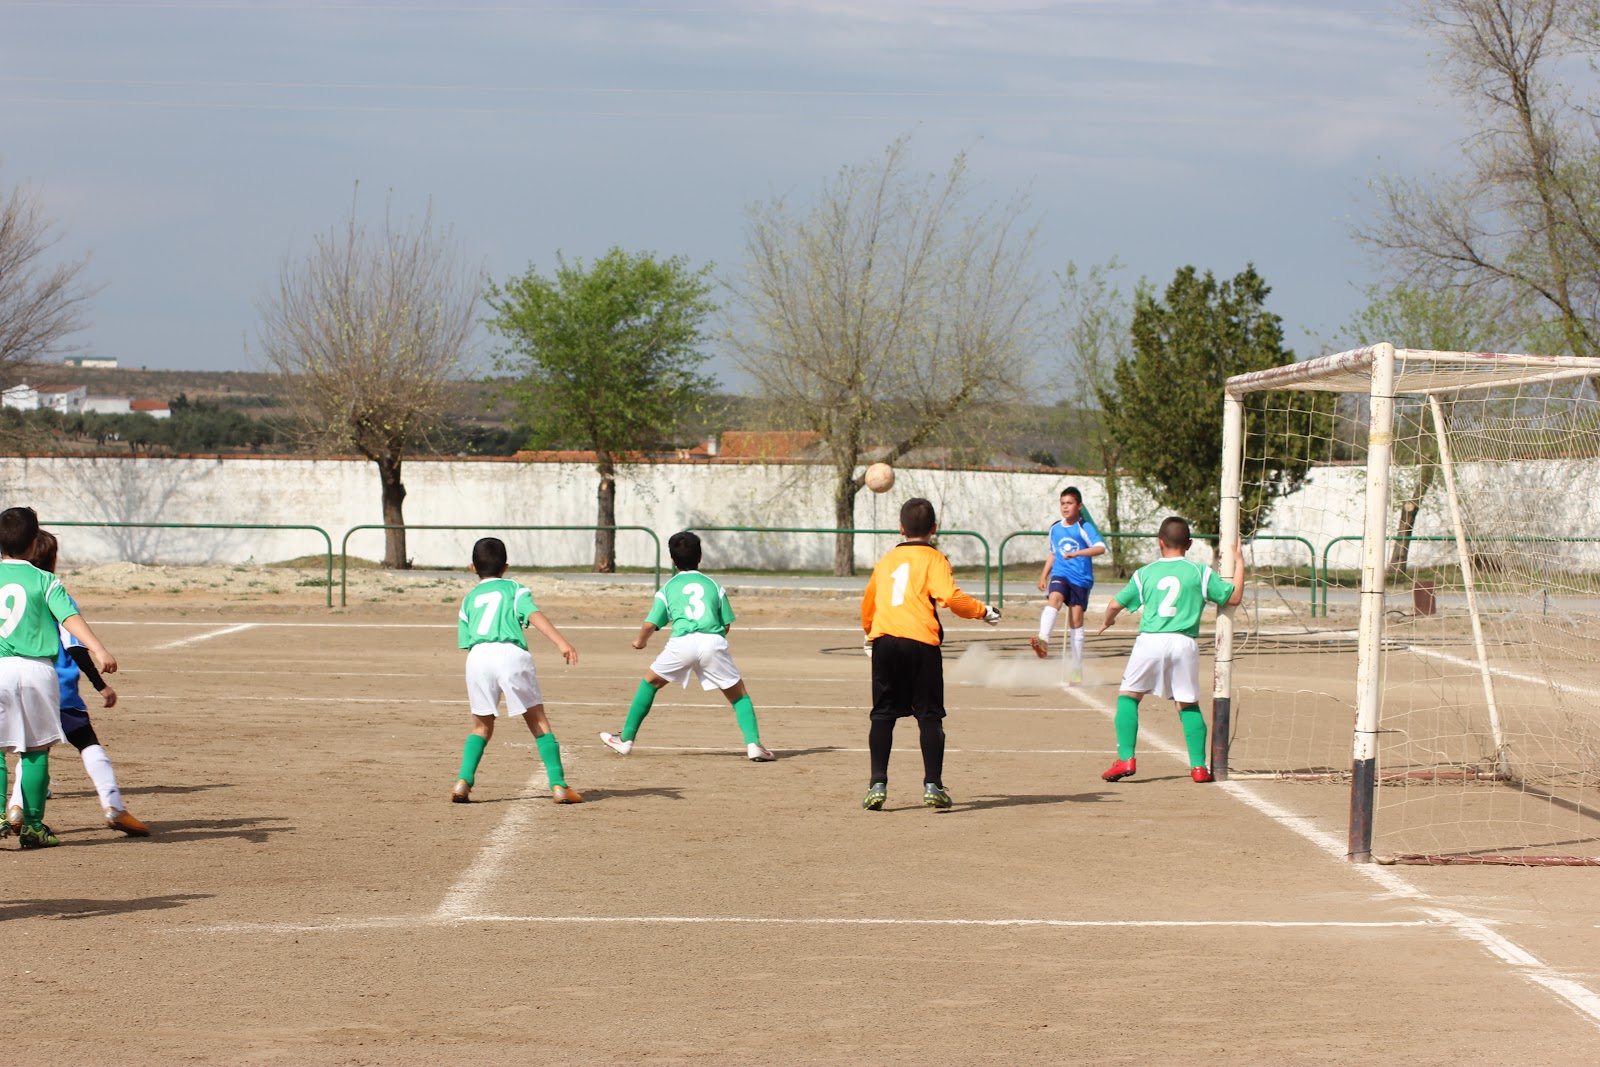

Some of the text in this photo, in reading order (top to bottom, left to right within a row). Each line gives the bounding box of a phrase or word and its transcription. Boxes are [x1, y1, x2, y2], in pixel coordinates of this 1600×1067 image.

[681, 583, 706, 621] 3
[890, 562, 910, 607] 1
[1156, 576, 1181, 618] 2
[0, 583, 27, 638] 9
[473, 591, 503, 635] 7
